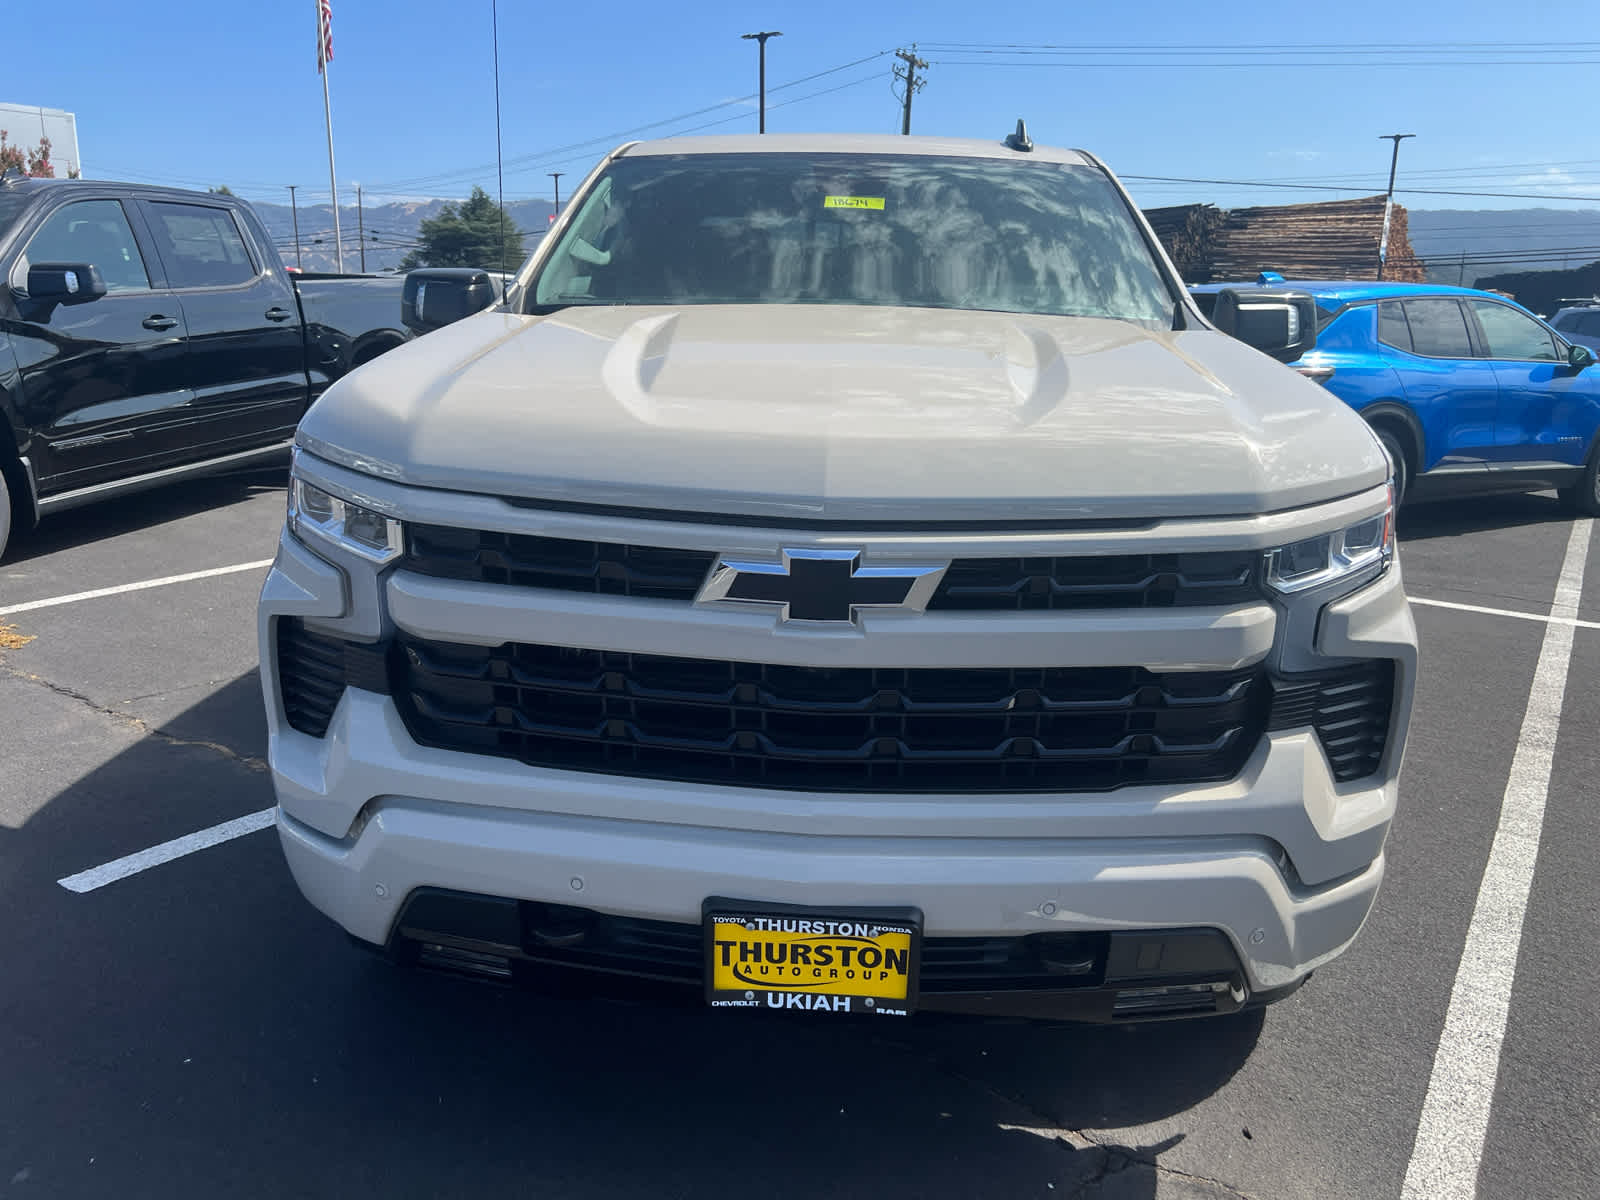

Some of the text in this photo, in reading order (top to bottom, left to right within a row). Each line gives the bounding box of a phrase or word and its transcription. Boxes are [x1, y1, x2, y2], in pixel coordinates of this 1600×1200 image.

[713, 916, 747, 924] TOYOTA
[754, 918, 868, 937] THURSTON
[873, 926, 912, 934] HONDA
[715, 940, 908, 975] THURSTON
[767, 992, 851, 1012] UKIAH
[876, 1008, 907, 1016] RAM
